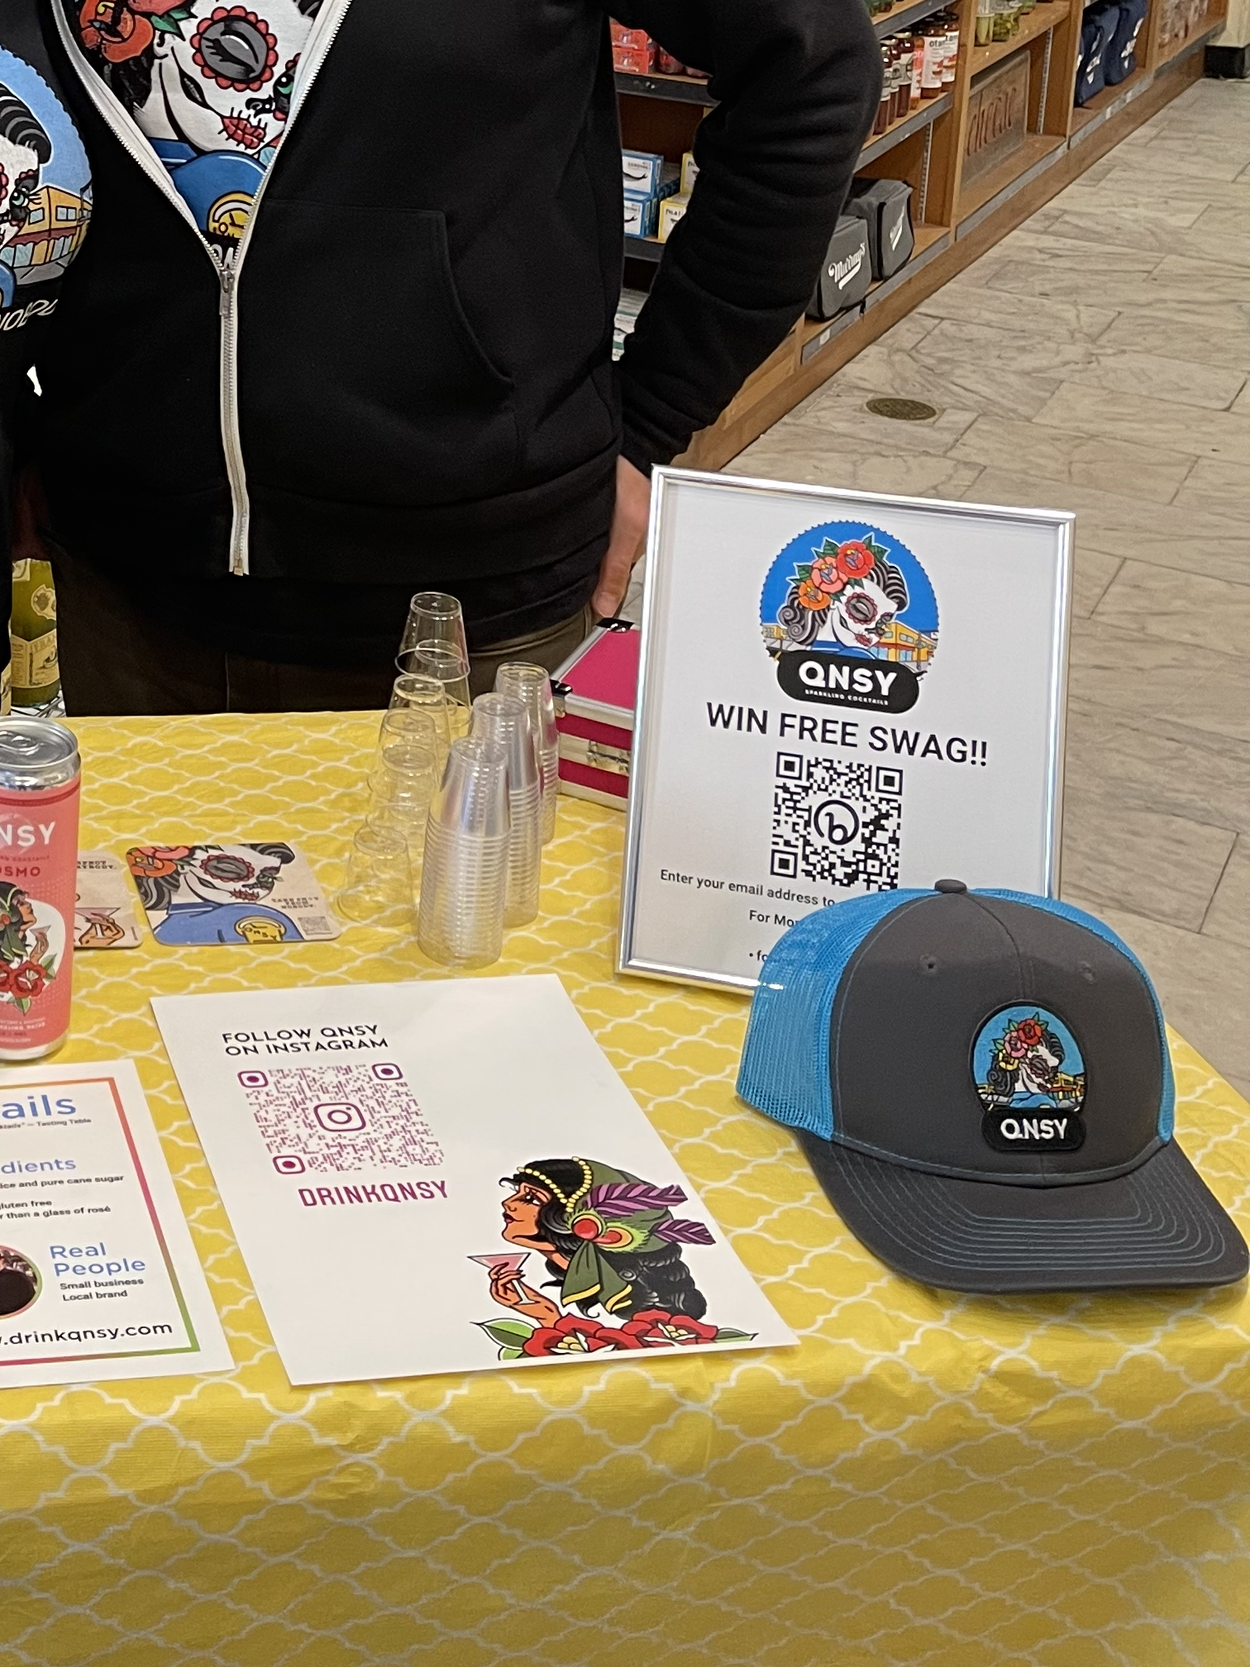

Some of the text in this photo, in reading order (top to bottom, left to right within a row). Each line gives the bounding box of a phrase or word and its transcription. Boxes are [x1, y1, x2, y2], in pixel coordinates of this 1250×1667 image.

[798, 659, 898, 696] QNSY
[805, 689, 889, 706] SPARKLING COCKTAILS
[706, 702, 988, 767] WIN FREE SWAG!!
[660, 869, 836, 907] Enter your email address to
[749, 909, 770, 924] For
[222, 1024, 379, 1044] FOLLOW QNSY
[225, 1038, 389, 1056] ON INSTAGRAM
[999, 1117, 1068, 1141] QNSY
[19, 1180, 38, 1188] and
[41, 1179, 64, 1188] pure
[94, 1175, 124, 1184] sugar
[298, 1180, 448, 1207] DRINKQNSY
[6, 1211, 30, 1219] than
[43, 1209, 71, 1218] glass
[87, 1205, 111, 1214] rosé
[49, 1242, 107, 1259] Real
[54, 1258, 146, 1277] People
[59, 1277, 145, 1290] Small business
[62, 1290, 128, 1301] Local brand
